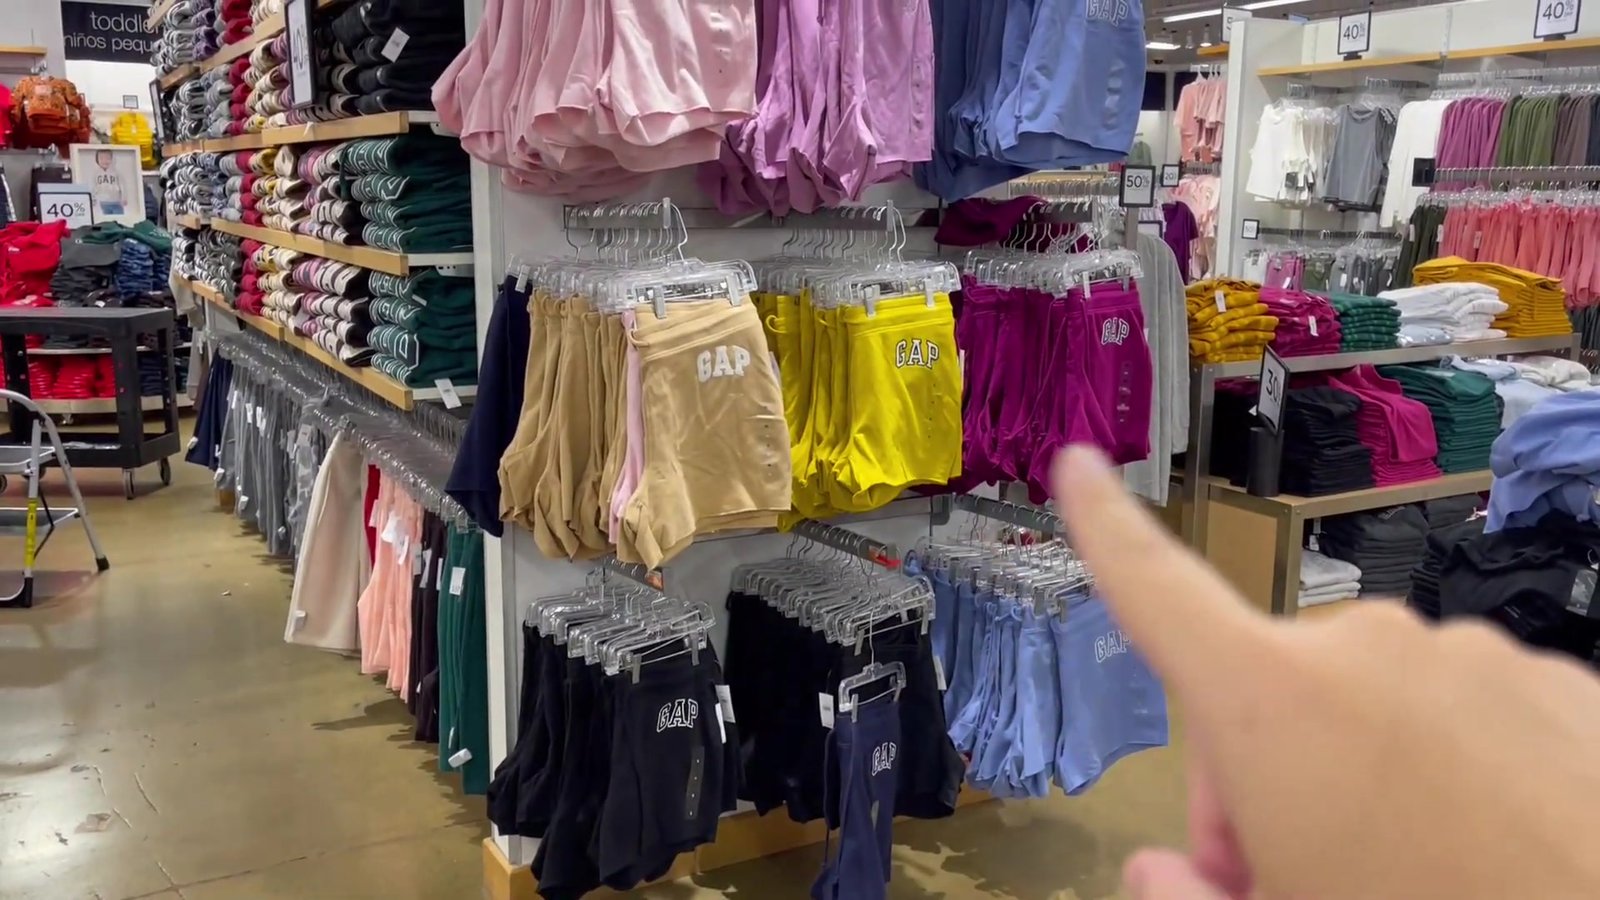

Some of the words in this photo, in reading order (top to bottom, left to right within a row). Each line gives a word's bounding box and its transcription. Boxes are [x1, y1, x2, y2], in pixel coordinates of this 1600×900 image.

[97, 174, 116, 184] GAP
[1101, 317, 1130, 345] GAP
[696, 344, 751, 383] GAP
[895, 339, 938, 370] GAP
[656, 698, 699, 733] GAP
[871, 742, 897, 776] GAP
